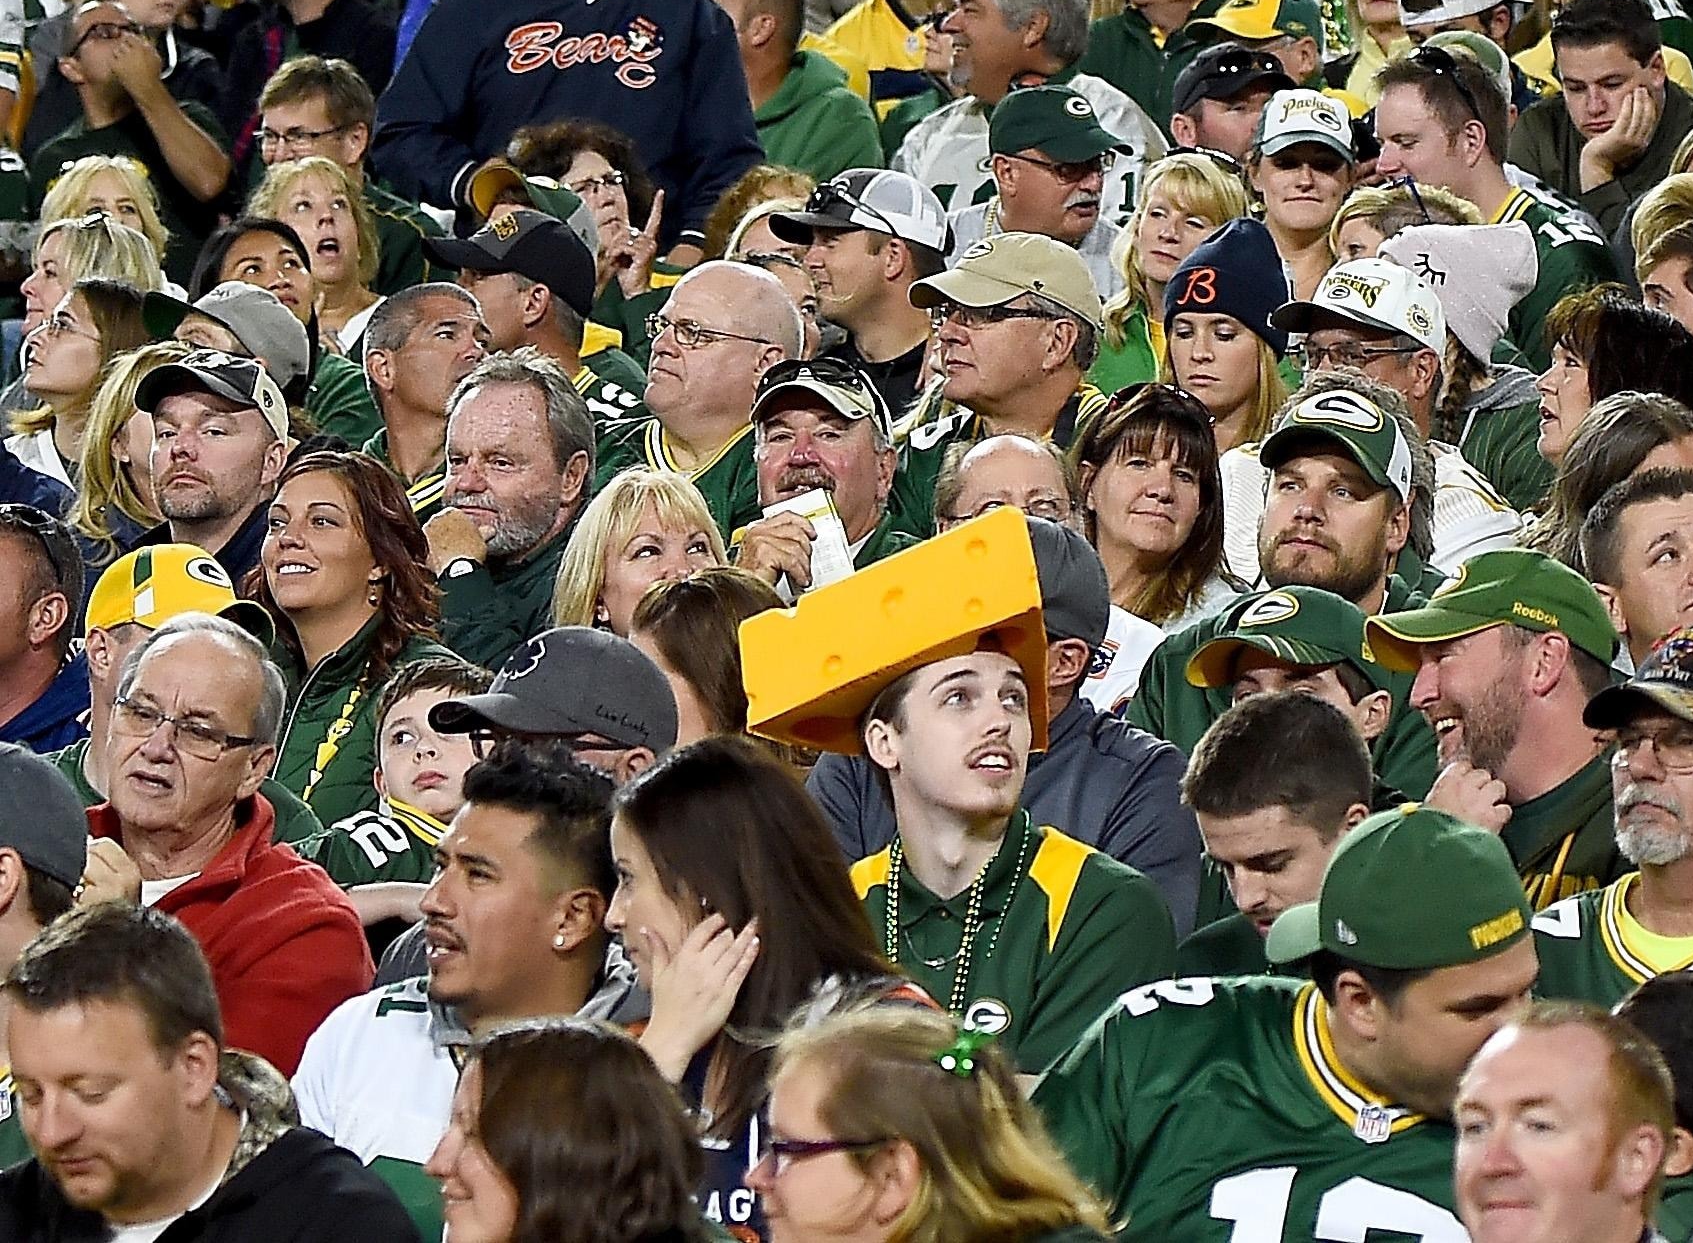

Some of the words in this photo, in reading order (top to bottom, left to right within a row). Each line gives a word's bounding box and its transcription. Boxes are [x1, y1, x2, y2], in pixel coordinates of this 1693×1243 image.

[614, 61, 657, 90] C
[1065, 96, 1095, 119] G
[1177, 267, 1217, 305] B
[1324, 277, 1382, 309] ACKERS
[1512, 600, 1561, 627] Reebok
[964, 998, 1013, 1035] G
